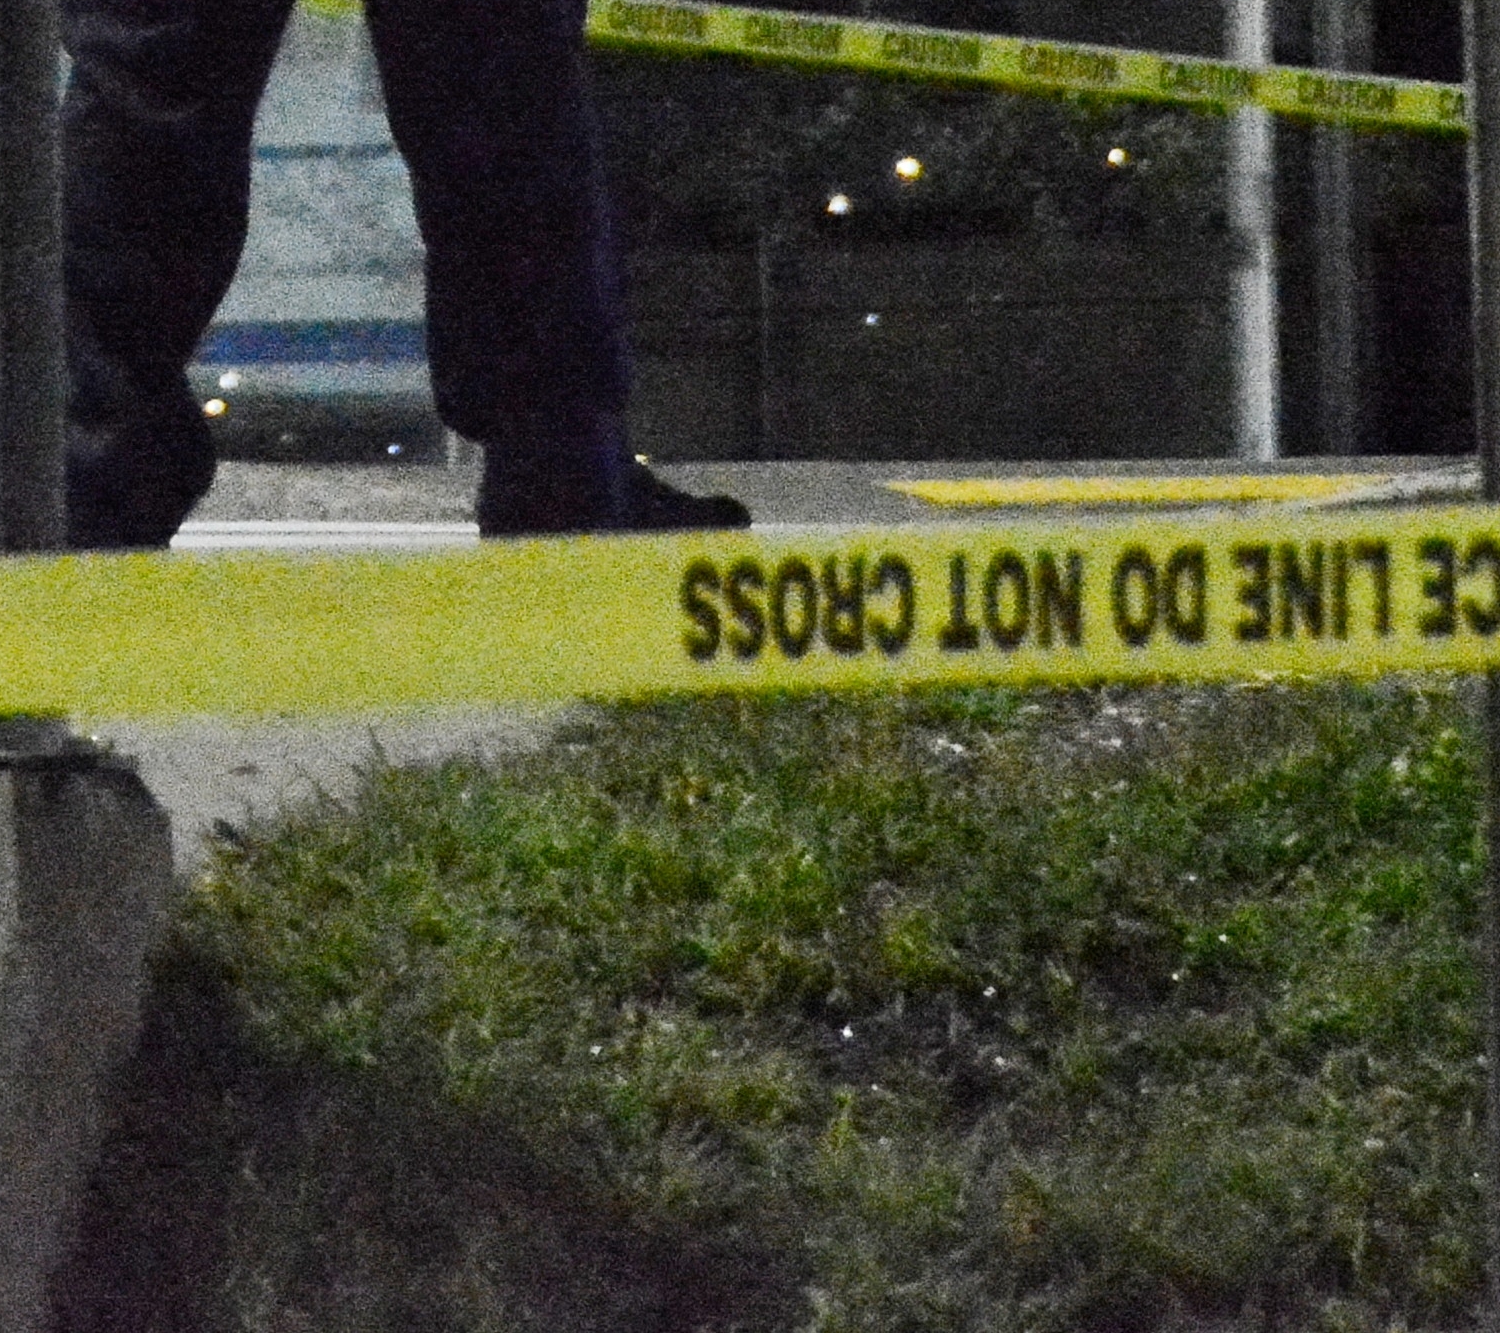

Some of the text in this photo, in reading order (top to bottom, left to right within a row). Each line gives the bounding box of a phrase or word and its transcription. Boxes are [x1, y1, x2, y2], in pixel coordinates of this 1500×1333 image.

[679, 552, 913, 662] CROSS
[939, 547, 1083, 651] NOT
[1112, 541, 1207, 648] DO
[1234, 537, 1391, 643] LINE
